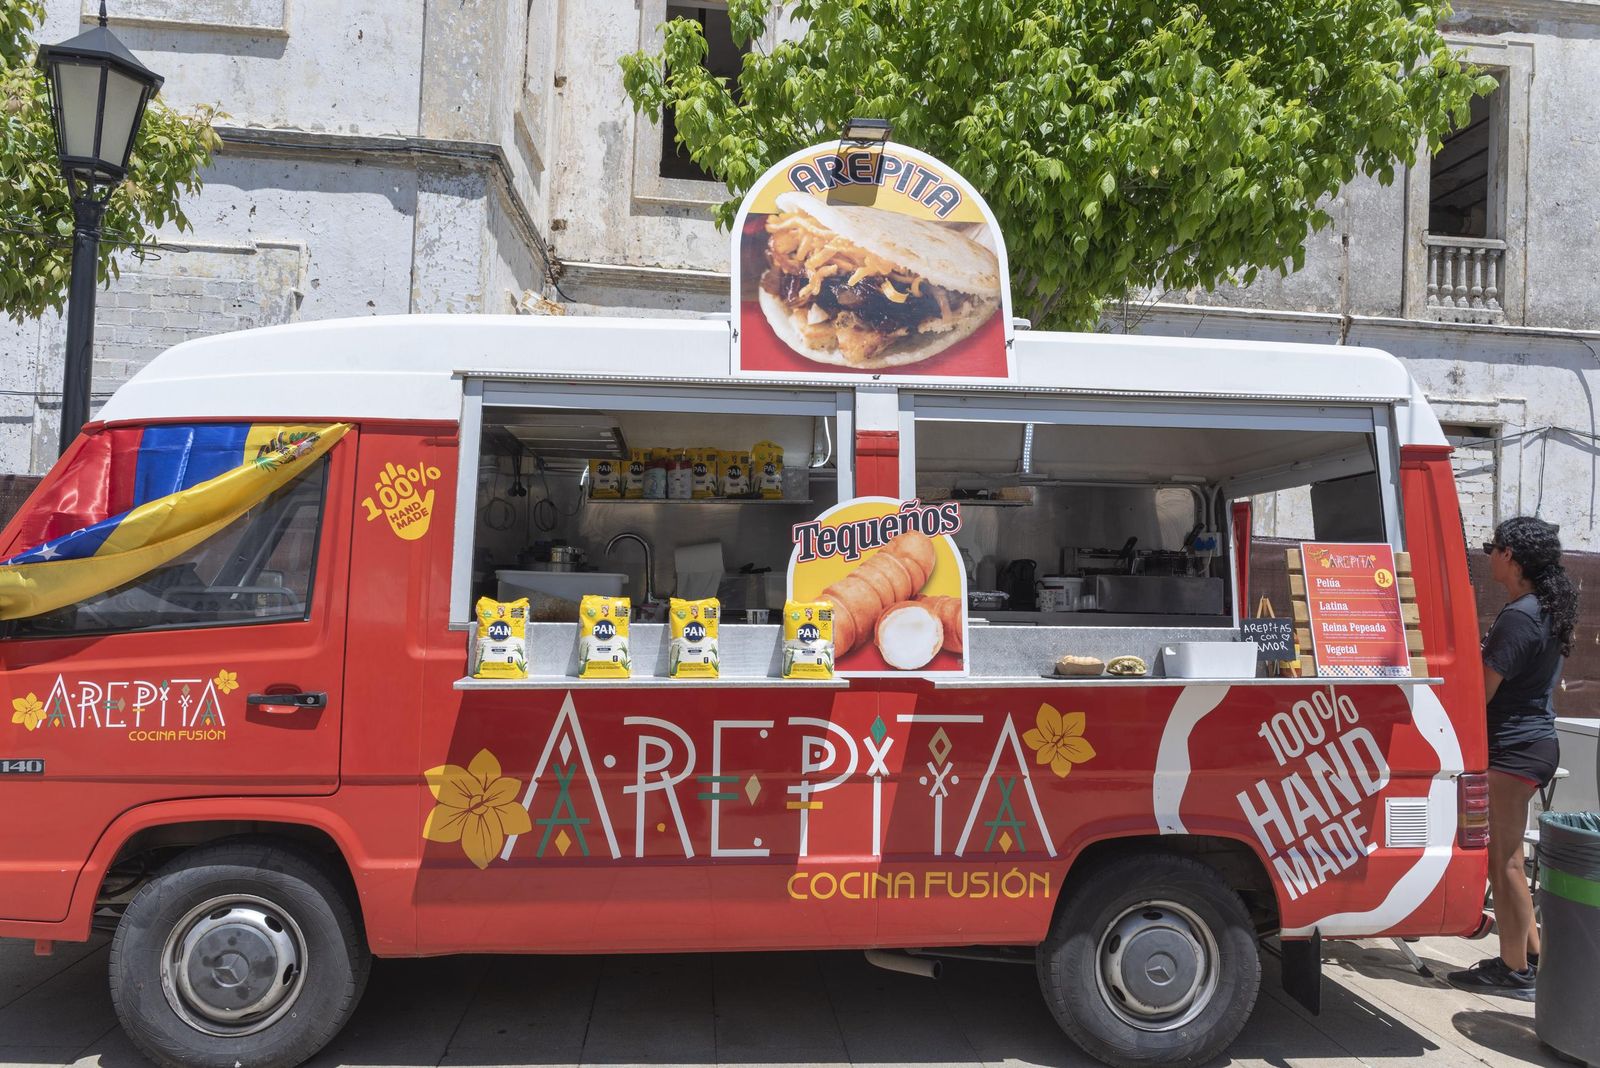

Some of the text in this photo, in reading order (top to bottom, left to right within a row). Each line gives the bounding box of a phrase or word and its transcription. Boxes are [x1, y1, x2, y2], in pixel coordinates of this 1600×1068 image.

[789, 152, 962, 219] AREPITA
[361, 461, 442, 522] 100%
[389, 501, 421, 523] HAND
[396, 507, 429, 530] MADE
[792, 498, 962, 563] Tequeños
[1328, 554, 1374, 568] AREPITA
[1316, 577, 1341, 588] Pelúa
[1319, 601, 1349, 611] Latina
[1322, 622, 1386, 634] Reina Pepeada
[1325, 644, 1358, 655] Vegetal
[36, 673, 226, 729] AREPITA
[128, 728, 227, 742] COCINA FUSIÓN
[1257, 685, 1360, 767] 100%
[2, 760, 42, 773] 140
[501, 691, 1057, 859] AREPITA
[1236, 726, 1391, 858] HAND
[1272, 807, 1378, 901] MADE
[787, 867, 1051, 901] COCINA FUSIÓN
